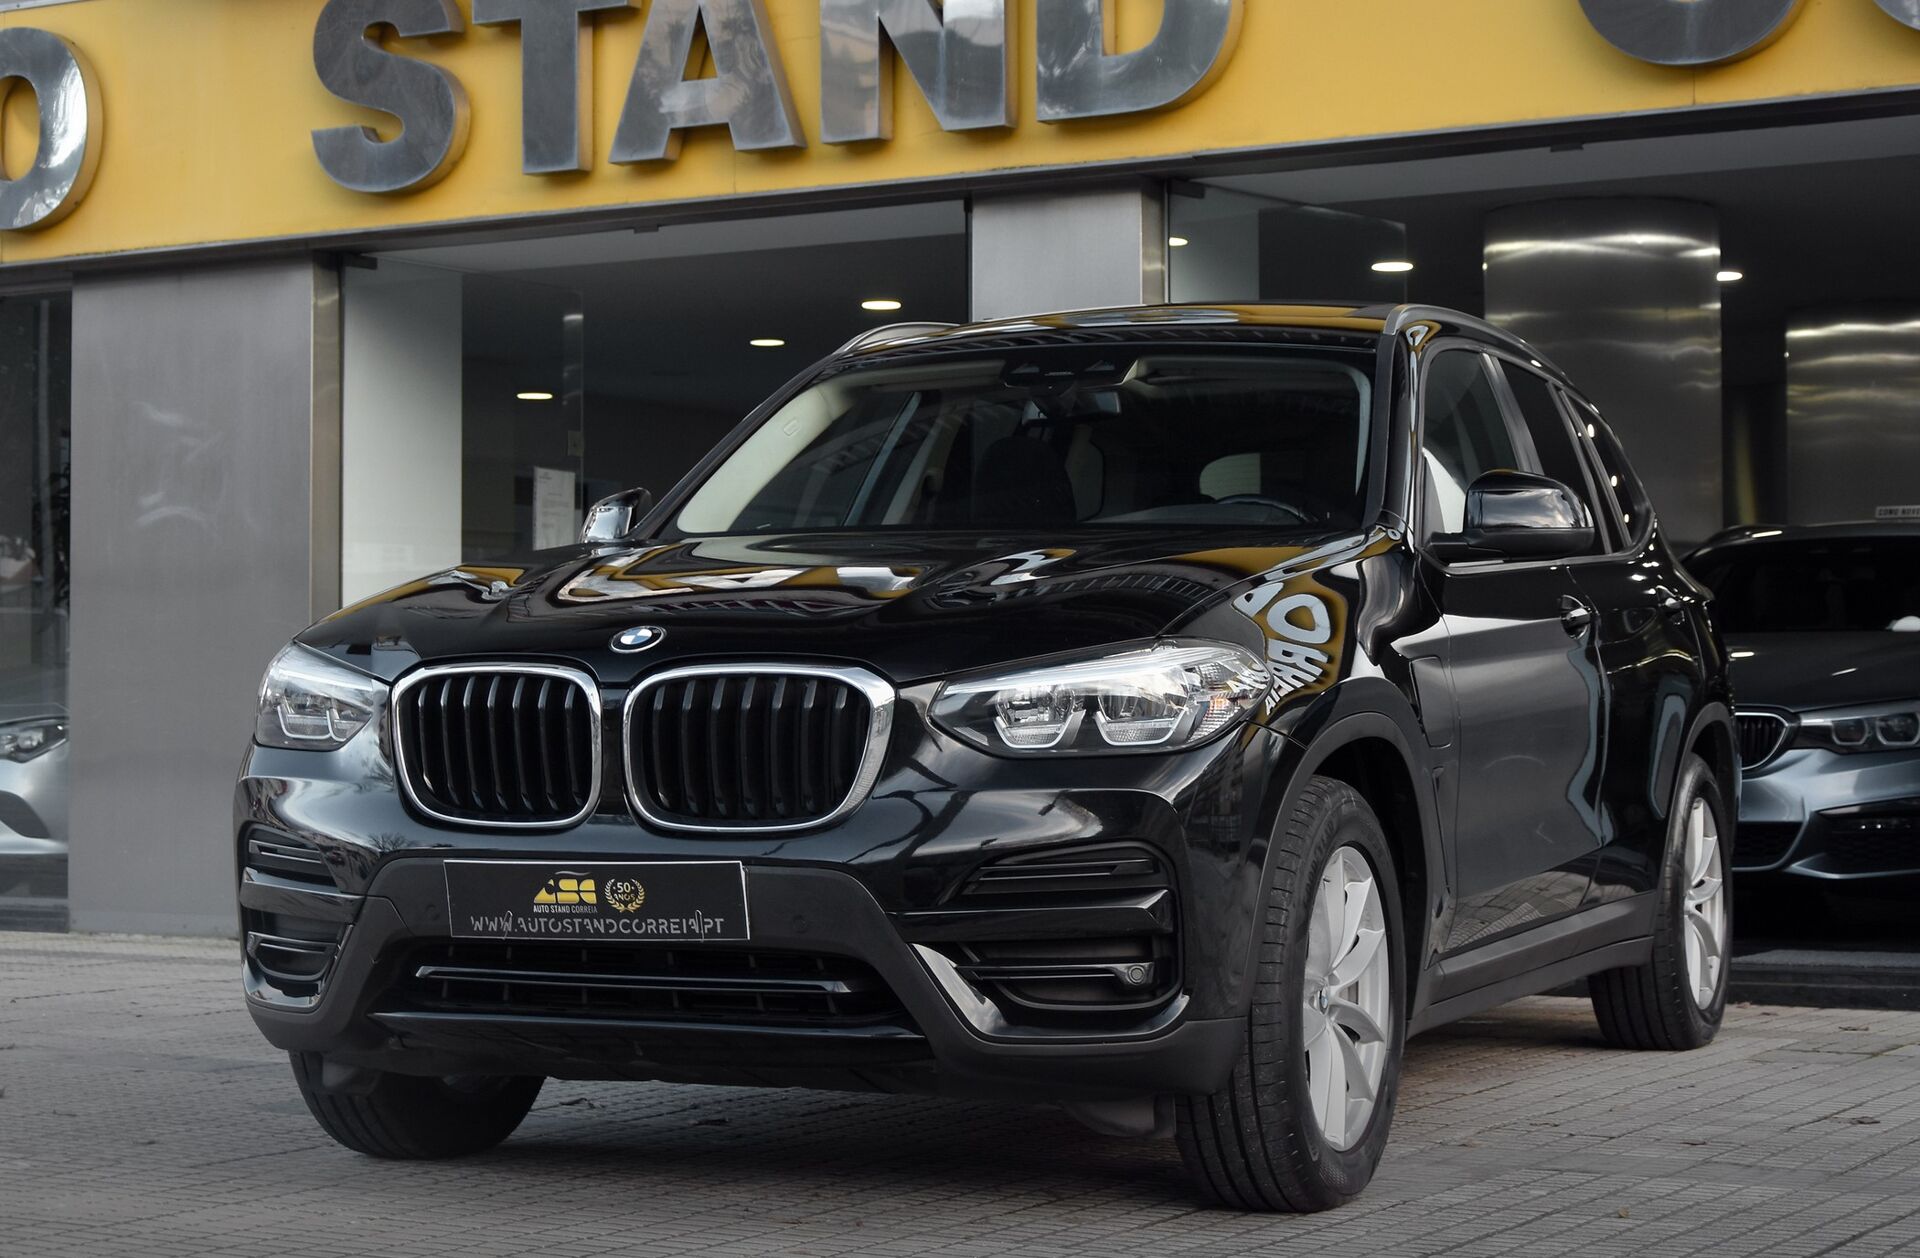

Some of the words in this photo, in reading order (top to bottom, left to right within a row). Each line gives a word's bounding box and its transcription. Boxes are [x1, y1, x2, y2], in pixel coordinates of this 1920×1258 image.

[310, 0, 1243, 194] STAND
[616, 882, 631, 893] 50
[533, 905, 549, 914] AUTO
[550, 905, 570, 914] STAND
[571, 905, 598, 914] CORREIA
